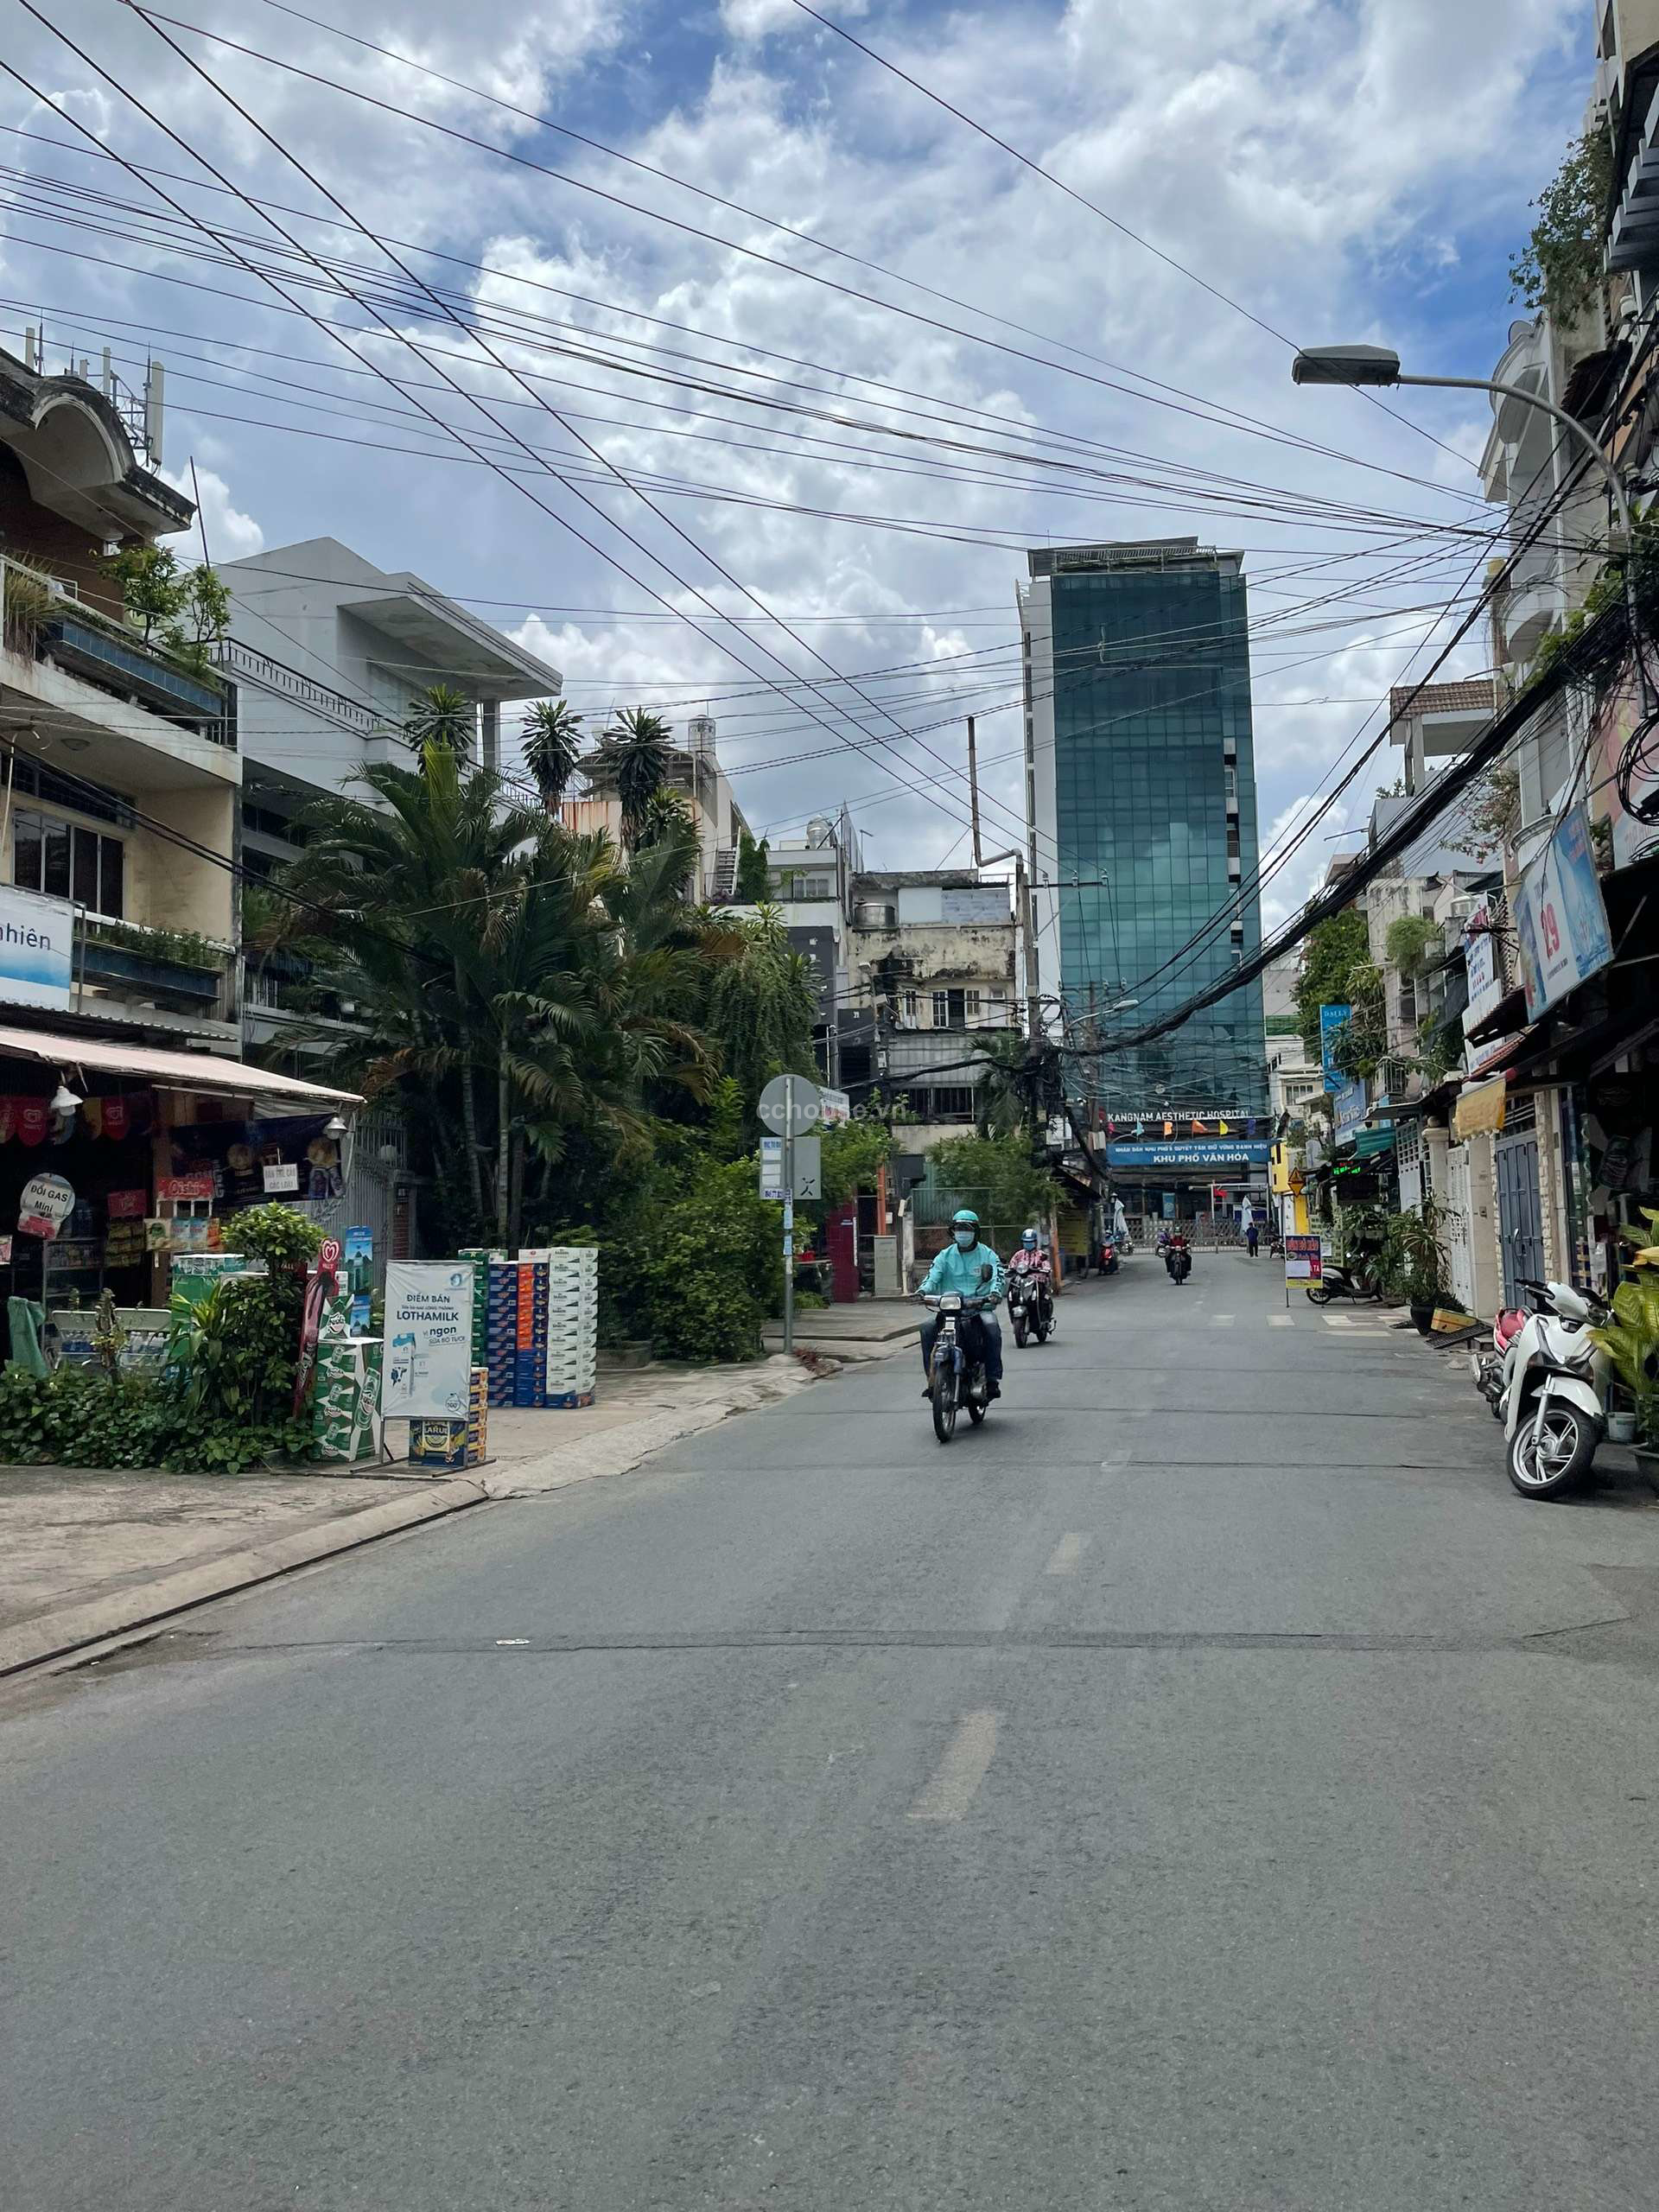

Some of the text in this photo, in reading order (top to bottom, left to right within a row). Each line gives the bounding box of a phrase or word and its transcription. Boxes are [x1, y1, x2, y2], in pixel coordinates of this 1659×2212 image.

[1108, 1113, 1154, 1122] KANGNAM
[1155, 1111, 1204, 1122] AESTHETIC
[1154, 1151, 1249, 1163] KHU PHỐ VĂN HÓA
[30, 1185, 68, 1202] ĐỔI GAS
[34, 1200, 54, 1212] Mini
[407, 1293, 450, 1303] ĐIỂM BÁN
[397, 1311, 459, 1321] LOTHAMILK
[429, 1326, 457, 1338] ngon
